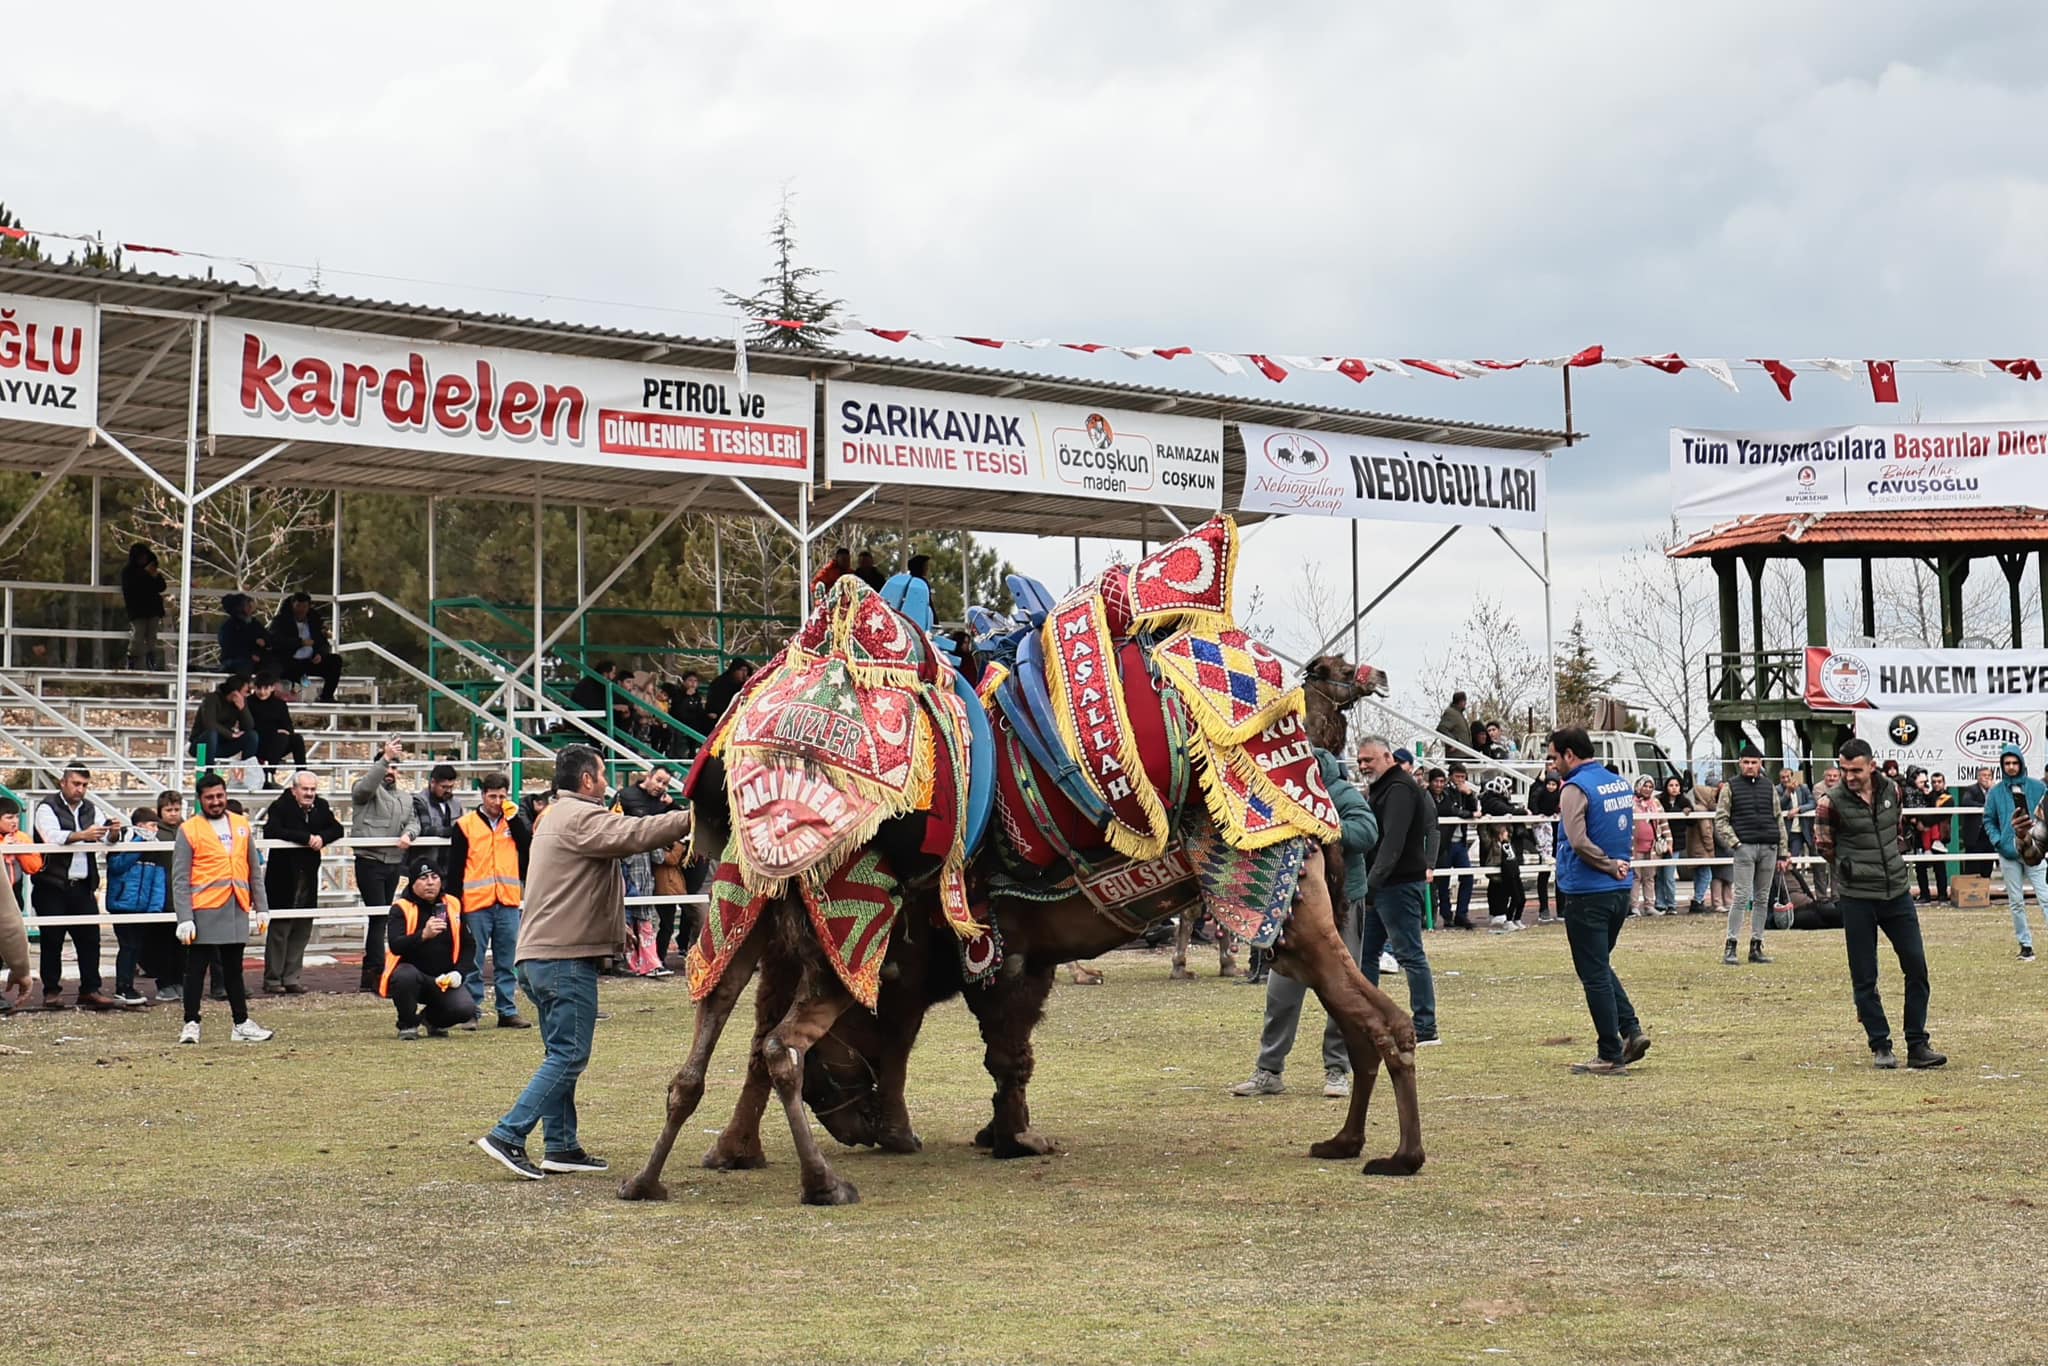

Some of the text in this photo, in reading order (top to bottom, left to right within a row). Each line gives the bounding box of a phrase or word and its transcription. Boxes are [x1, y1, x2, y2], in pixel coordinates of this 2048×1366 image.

[240, 334, 590, 446] kardelen
[643, 378, 765, 418] PETROL ve
[604, 414, 801, 461] DİNLENME TESİSLERİ
[841, 400, 1026, 448] SARIKAVAK
[842, 442, 1029, 477] DİNLENME TESİSİ
[1059, 443, 1149, 475] özcoşkun
[1156, 444, 1220, 465] RAMAZAN
[1683, 429, 2047, 467] Tüm Yarışmacılara Başarılar Diler
[1083, 475, 1127, 493] maden
[1162, 470, 1215, 491] COŞKUN
[1350, 450, 1536, 513] NEBİOĞULLARI
[1868, 475, 1979, 497] ÇAVUŞOĞLU
[1297, 494, 1342, 516] Kasap
[1880, 665, 2048, 694] HAKEM HEYE
[1063, 614, 1133, 802] MAŞALLAH
[775, 706, 862, 760] KIZLER
[1966, 728, 2021, 746] SABIR
